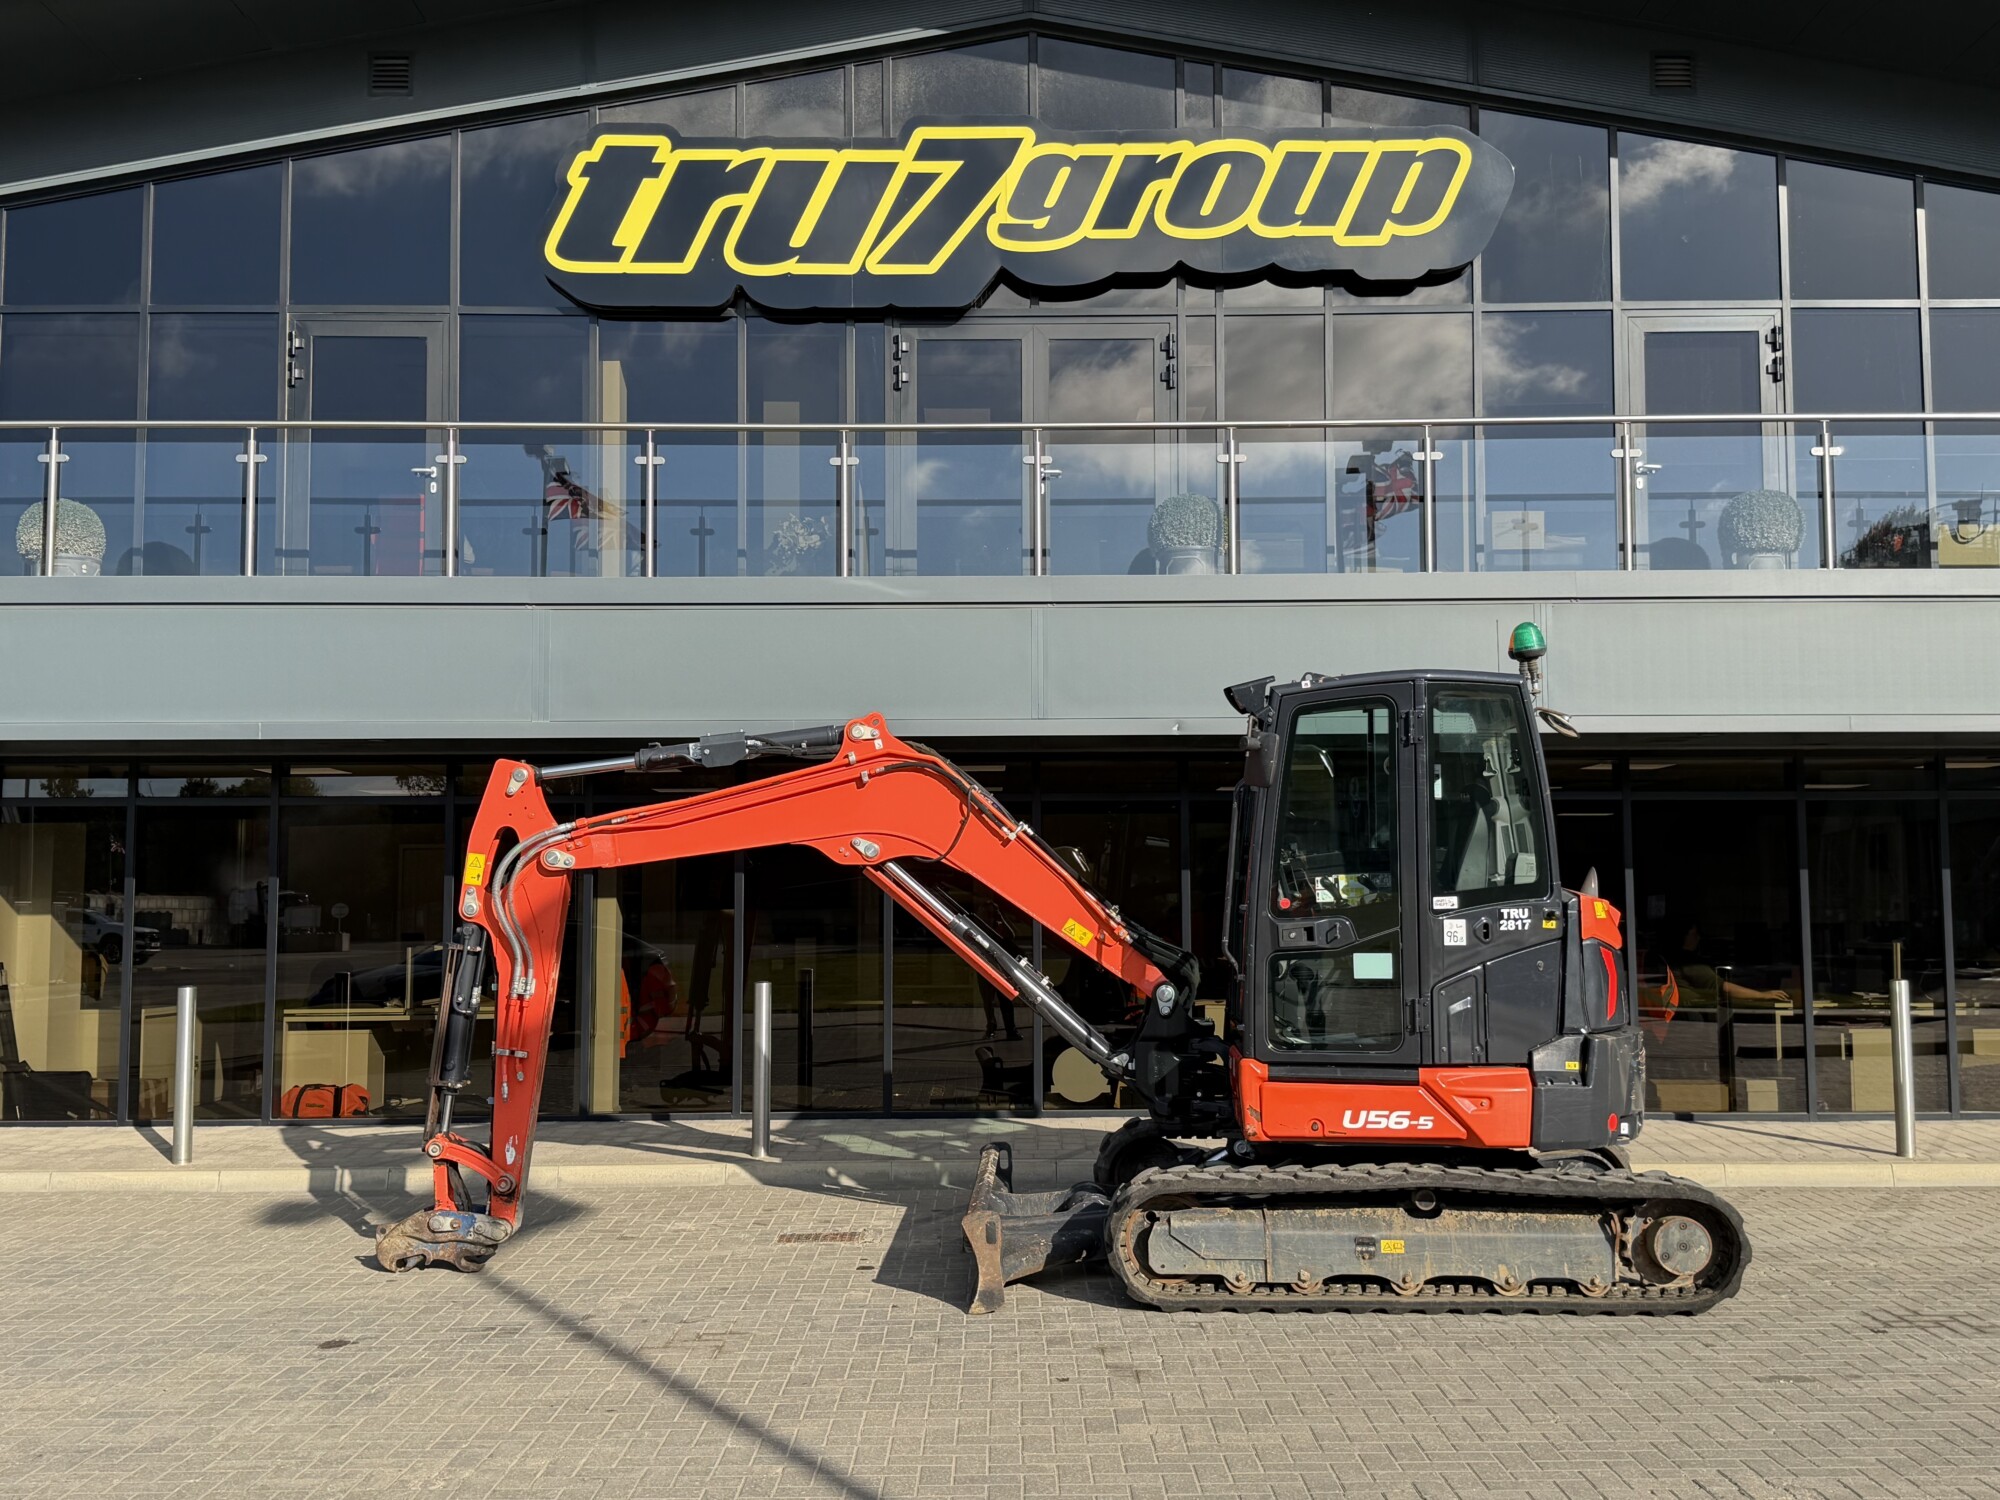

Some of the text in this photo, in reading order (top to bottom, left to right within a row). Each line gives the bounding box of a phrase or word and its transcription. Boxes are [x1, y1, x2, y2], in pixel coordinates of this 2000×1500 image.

[1500, 908, 1529, 919] TRU
[1500, 919, 1532, 931] 2817
[1342, 1109, 1435, 1130] U56-5
